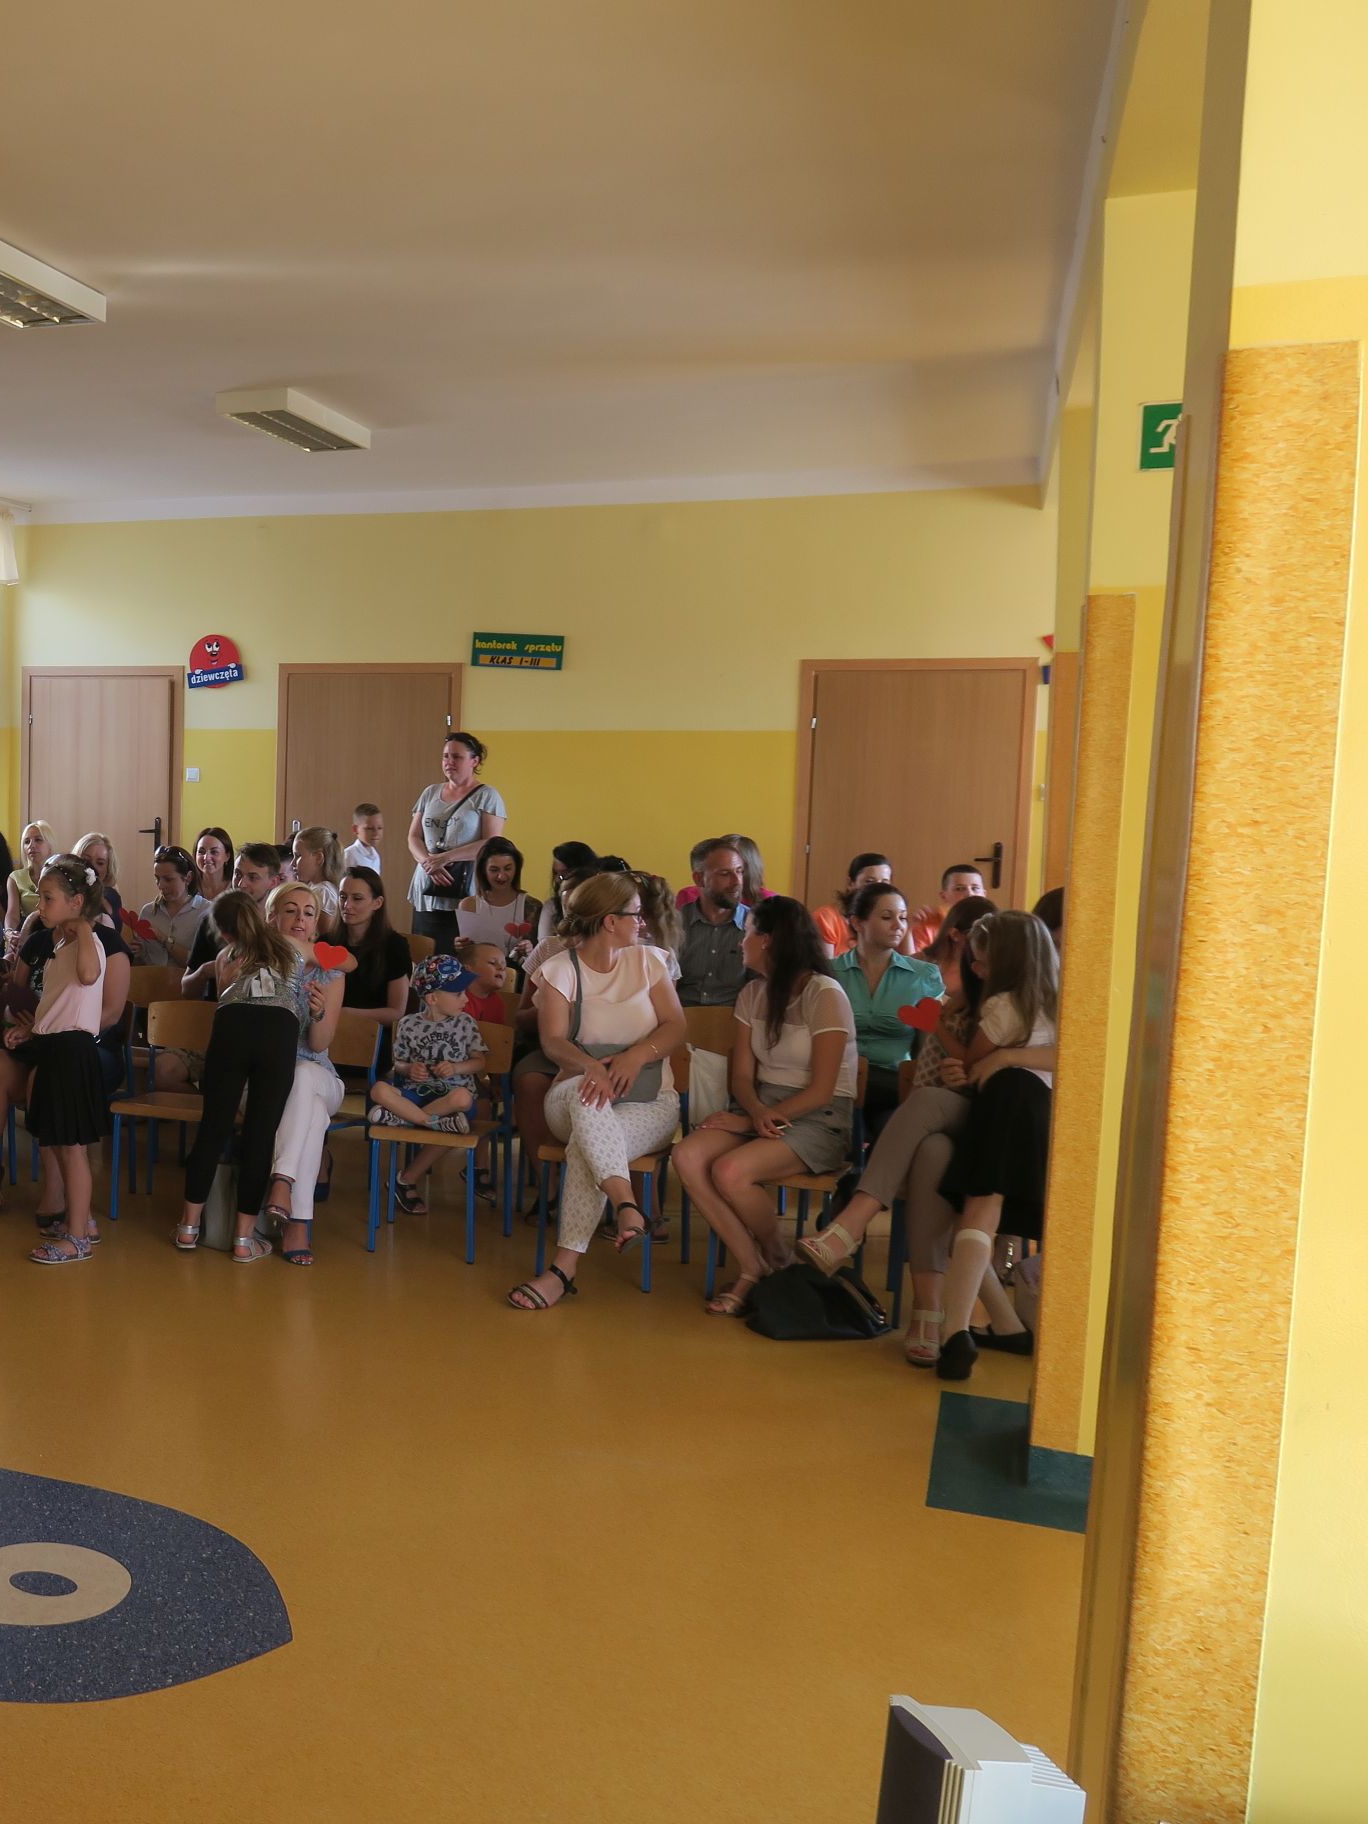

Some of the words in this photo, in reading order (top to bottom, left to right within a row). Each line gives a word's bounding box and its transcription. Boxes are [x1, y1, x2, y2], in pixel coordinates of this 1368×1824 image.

[475, 639, 518, 650] kantorek
[489, 656, 513, 665] KLAS
[191, 668, 238, 684] dziewczęta
[424, 816, 460, 829] ENJOY
